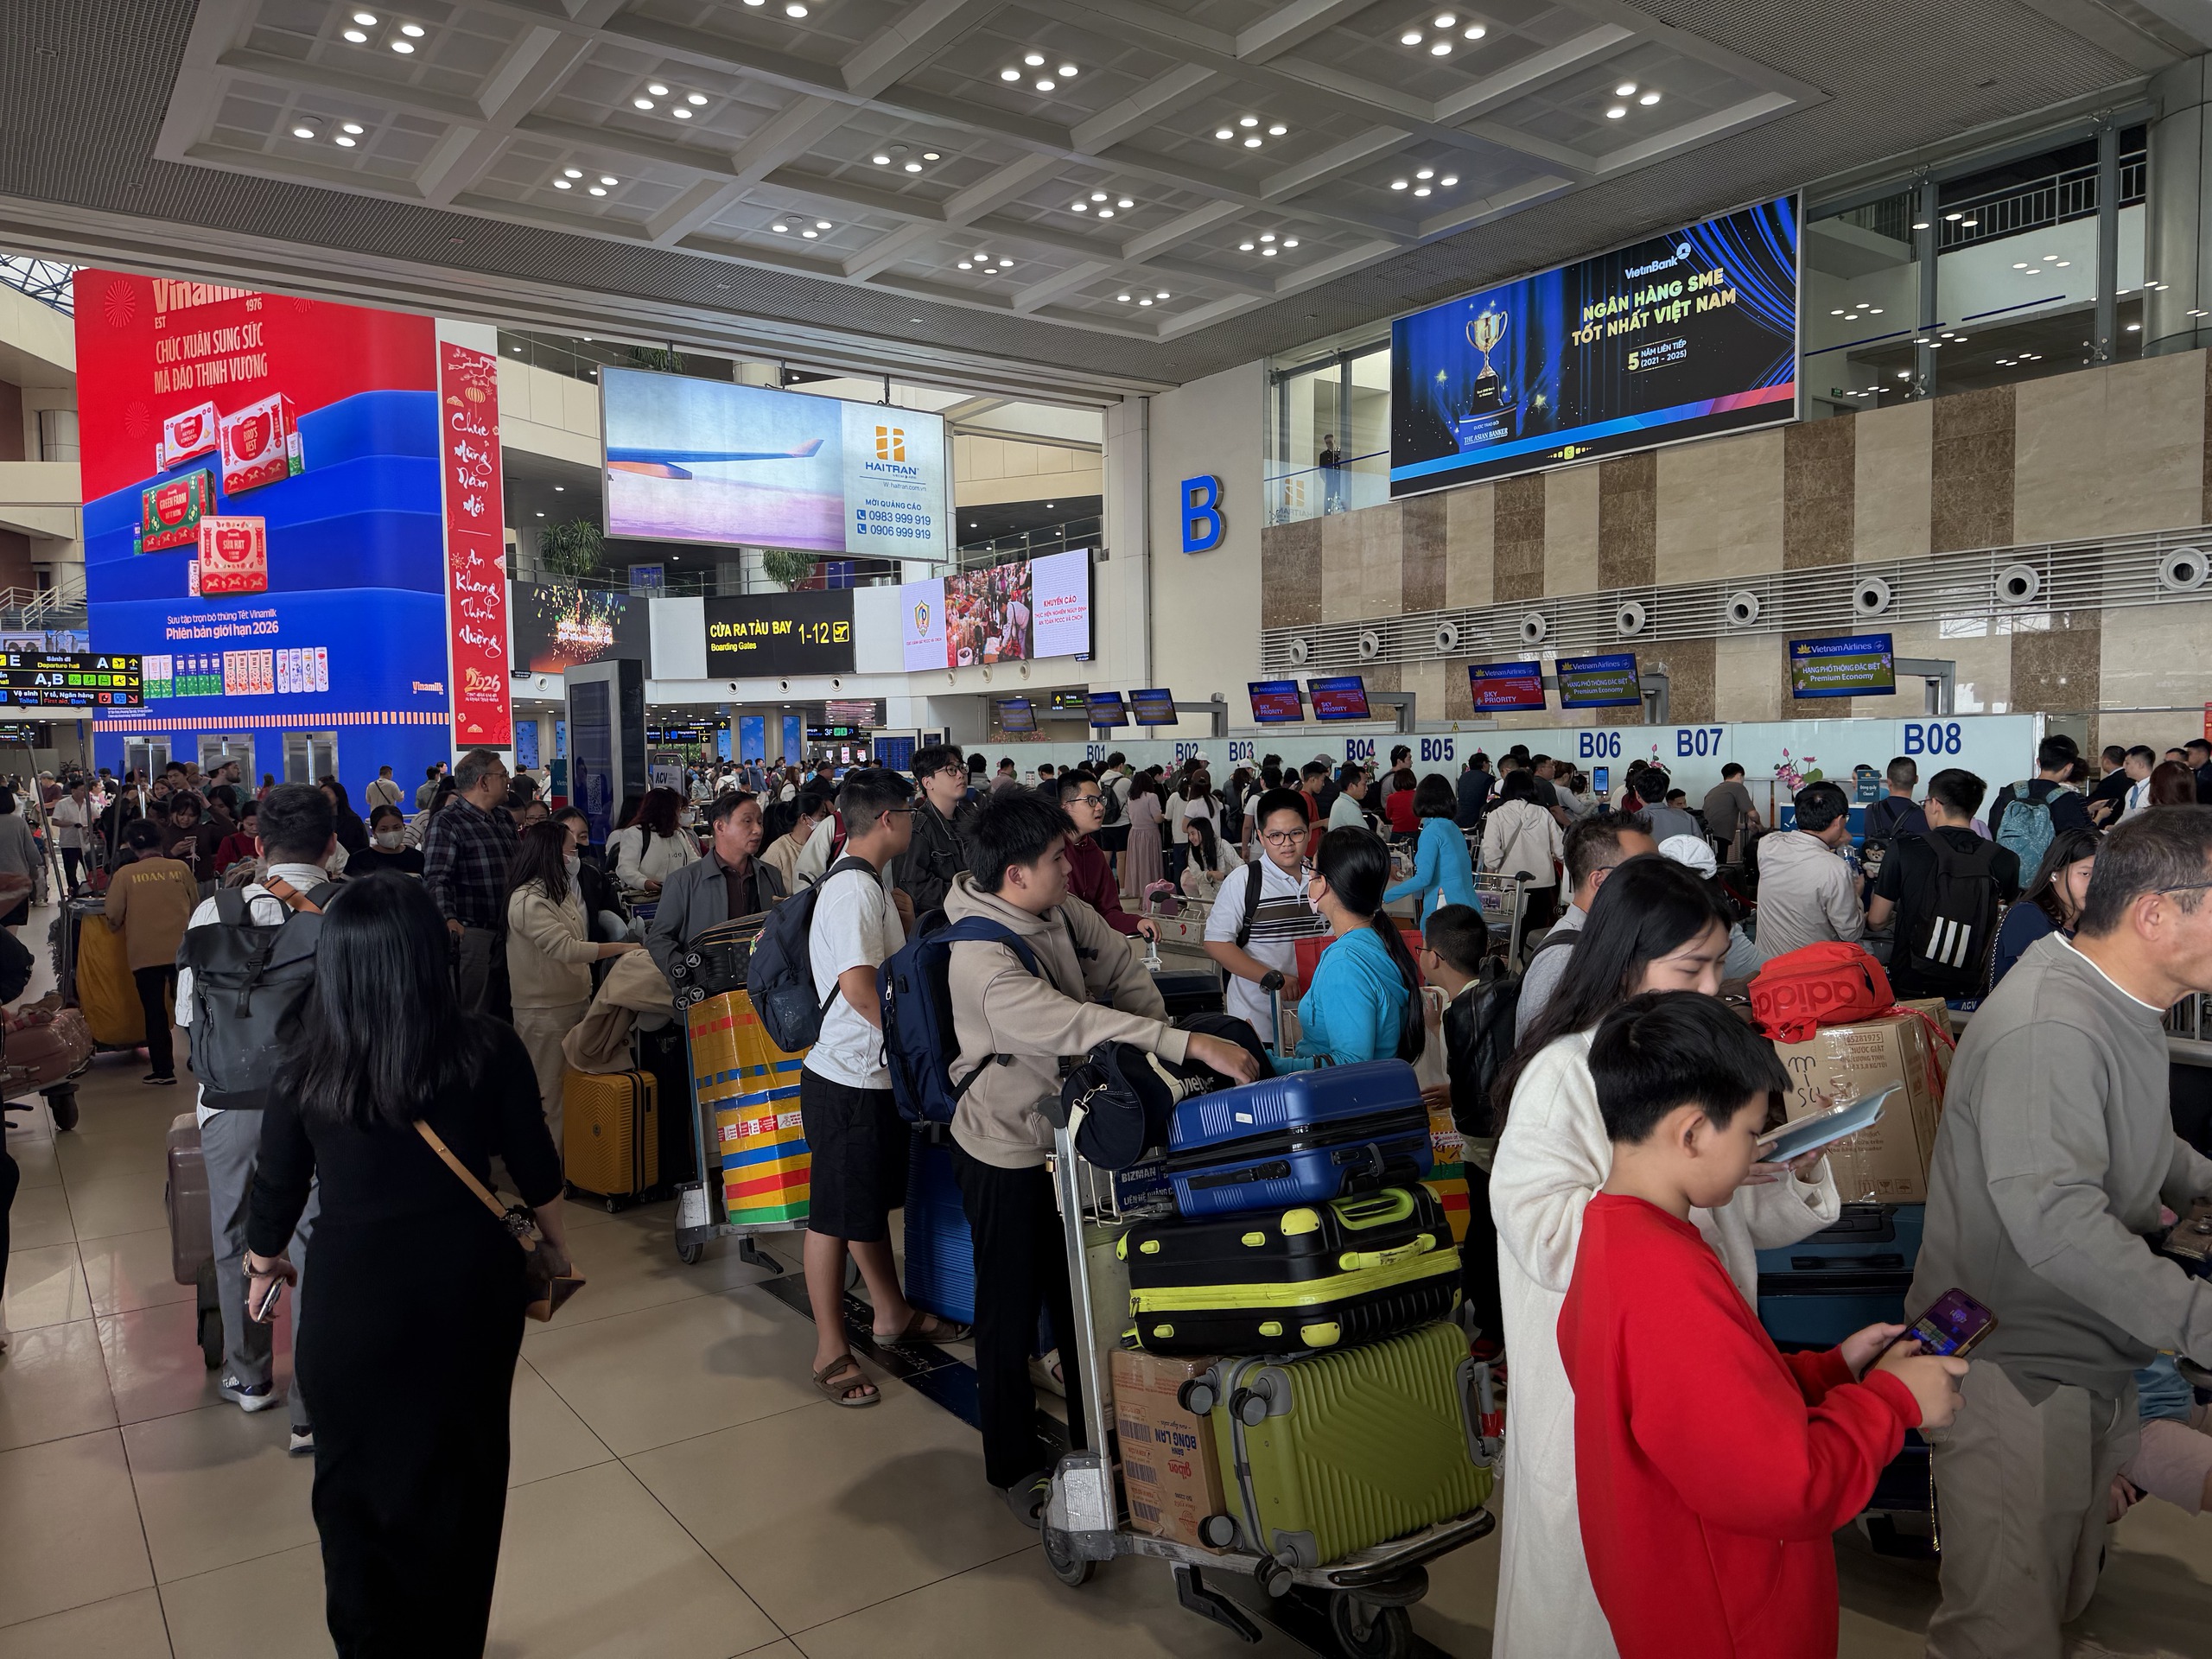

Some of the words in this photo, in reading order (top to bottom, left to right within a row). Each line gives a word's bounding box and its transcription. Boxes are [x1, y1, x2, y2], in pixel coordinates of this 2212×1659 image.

[245, 297, 263, 312] 1976
[1583, 295, 1629, 322] NGÂN
[1634, 280, 1683, 308] HÀNG
[1688, 268, 1724, 292] SME
[155, 315, 167, 329] EST
[1572, 321, 1603, 346] TỐT
[1607, 308, 1649, 337] NHẤT
[1655, 300, 1692, 324] VIỆT
[1696, 288, 1737, 313] NAM
[156, 336, 181, 364] CHÚC
[183, 331, 211, 360] XUÂN
[213, 326, 240, 354] SUNG
[242, 321, 264, 350] SỨC
[1628, 352, 1640, 371] 5
[1641, 346, 1656, 359] NĂM
[1657, 343, 1671, 354] LIÊN
[1673, 338, 1687, 350] TIẾP
[155, 367, 171, 394] MÃ
[172, 364, 194, 391] ĐÁO
[195, 359, 228, 389] THỊNH
[229, 353, 268, 382] VƯỢNG
[452, 411, 489, 436] Chúc
[456, 467, 489, 493] Năm
[880, 500, 906, 509] QUẢNG
[906, 502, 922, 511] CÁO
[1180, 474, 1224, 554] B
[869, 511, 893, 522] 0983
[895, 513, 913, 524] 999
[915, 516, 931, 526] 919
[870, 524, 894, 537] 0906
[895, 527, 913, 538] 999
[915, 529, 931, 539] 919
[465, 549, 485, 569] An
[455, 570, 500, 607] Khang
[1064, 594, 1077, 604] CÁO
[250, 608, 276, 618] Vinamilk
[461, 597, 496, 624] Thịnh
[166, 625, 193, 640] Phiên
[194, 623, 213, 639] bản
[213, 624, 232, 639] giới
[233, 623, 251, 637] hạn
[252, 620, 279, 634] 2026
[709, 621, 732, 638] CỬA
[733, 624, 747, 637] RA
[748, 619, 769, 636] TÀU
[772, 620, 792, 635] BAY
[798, 622, 830, 645] 1-12
[459, 625, 502, 658] Vượng
[711, 642, 738, 652] Boarding
[739, 641, 757, 651] Gates
[1811, 645, 1843, 653] Vietnam
[1843, 643, 1872, 652] Airlines
[10, 655, 22, 666] E
[96, 657, 109, 669] A
[1842, 672, 1874, 681] Economy
[412, 681, 444, 693] Vinamilk
[1579, 731, 1621, 758] B06
[1676, 728, 1723, 757] B07
[1904, 722, 1961, 754] B08
[1087, 744, 1105, 762] B01
[1175, 742, 1198, 761] B02
[1229, 741, 1254, 761] B03
[1346, 739, 1375, 760] B04
[1421, 738, 1454, 761] B05
[1121, 1166, 1156, 1183] BIZMAN
[1154, 1428, 1171, 1444] LAN
[1173, 1433, 1197, 1451] BÔNG
[1168, 1461, 1192, 1479] gibon
